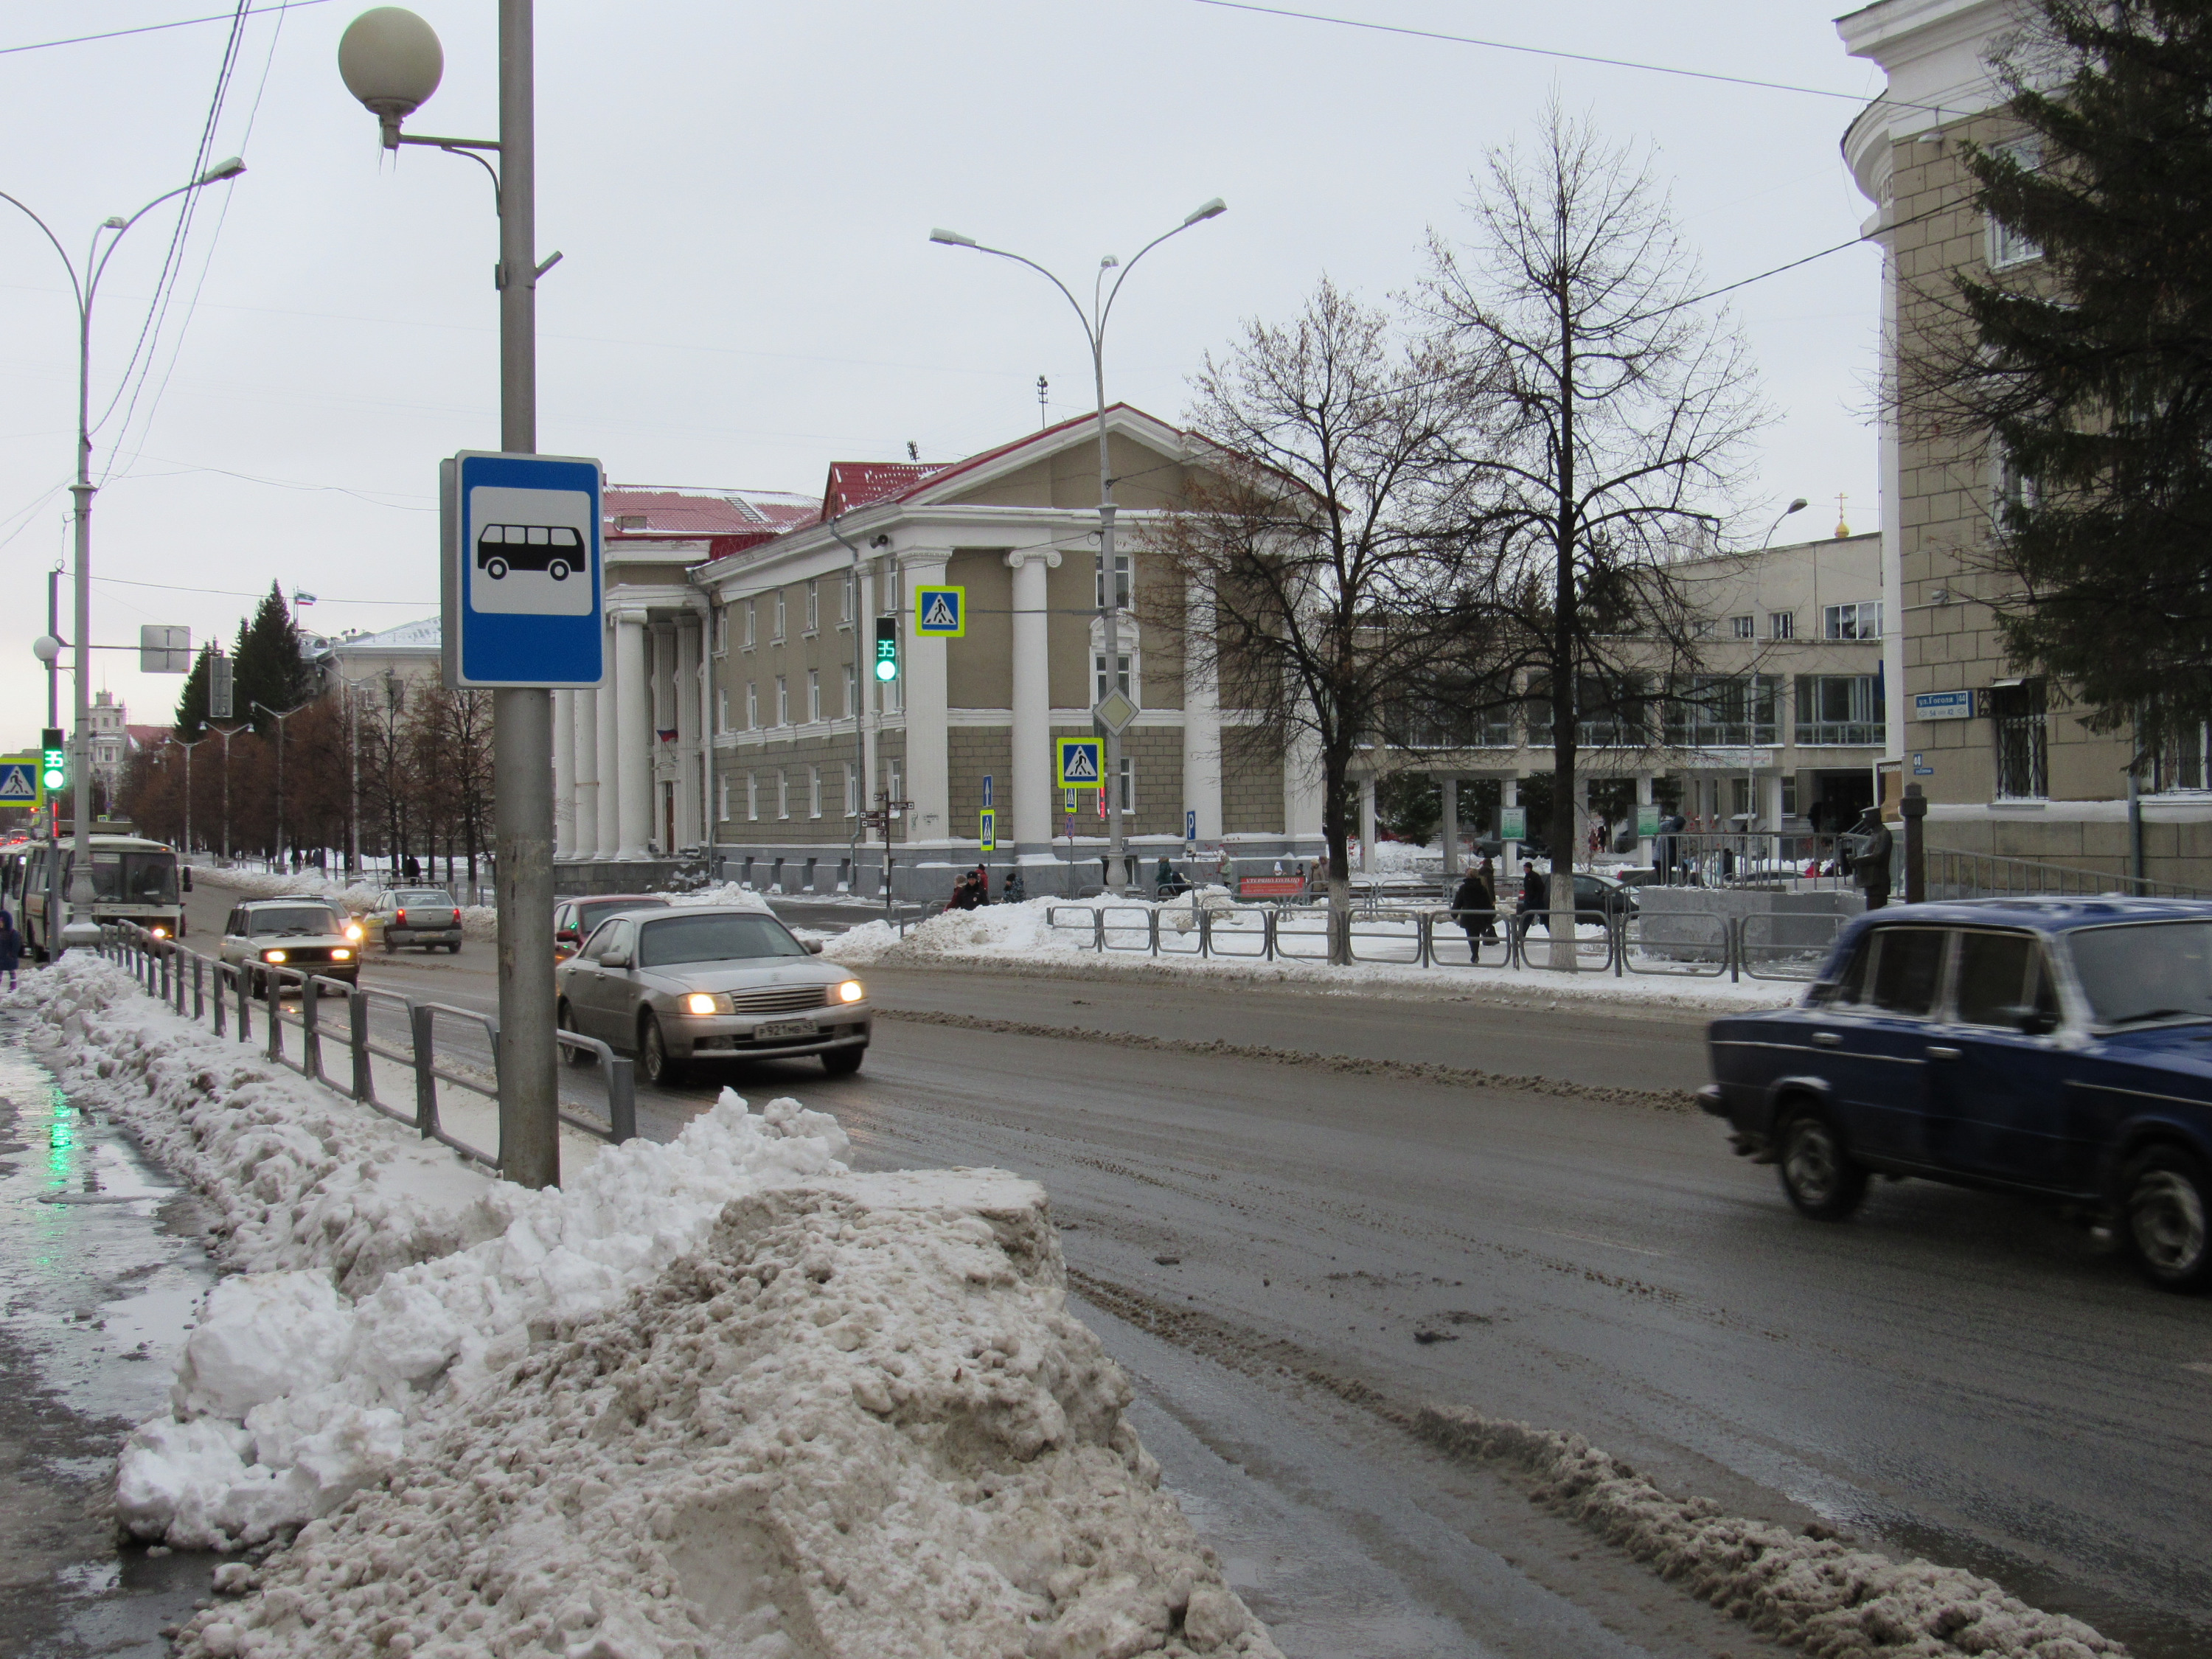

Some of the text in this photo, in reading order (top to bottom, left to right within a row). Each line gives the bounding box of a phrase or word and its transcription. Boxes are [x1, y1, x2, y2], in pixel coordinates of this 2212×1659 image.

[878, 641, 894, 657] 35
[1919, 695, 1966, 706] ул.Гоголя 44
[45, 751, 63, 767] 35
[1913, 755, 1921, 766] 44
